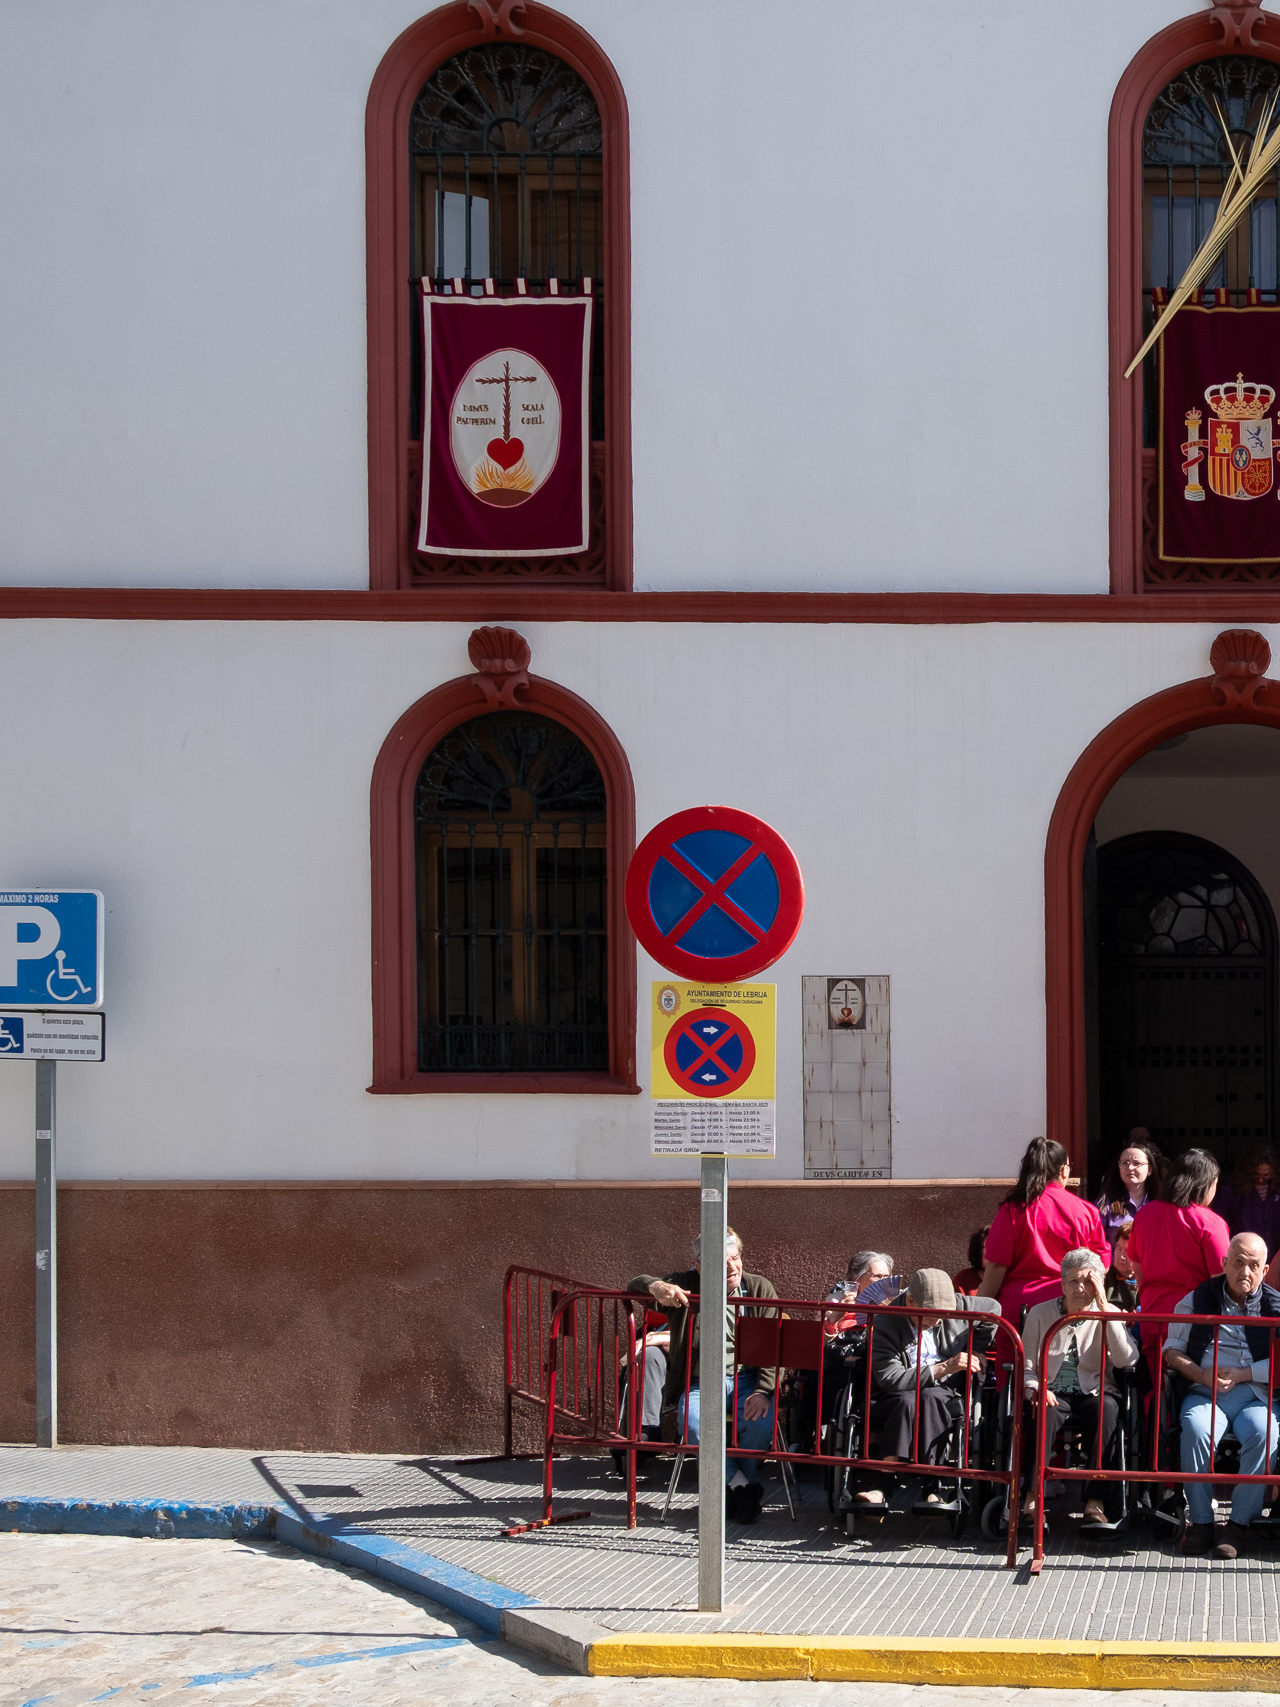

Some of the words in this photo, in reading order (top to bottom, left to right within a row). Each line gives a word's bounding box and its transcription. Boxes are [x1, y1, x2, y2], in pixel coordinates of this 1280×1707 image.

[463, 404, 489, 412] DOMUS
[521, 403, 545, 411] SCALA
[28, 894, 33, 903] 2
[34, 894, 59, 903] HORAS
[0, 906, 61, 987] P
[687, 990, 732, 998] AYUNTAMIENTO
[743, 991, 768, 999] LEBRIJA
